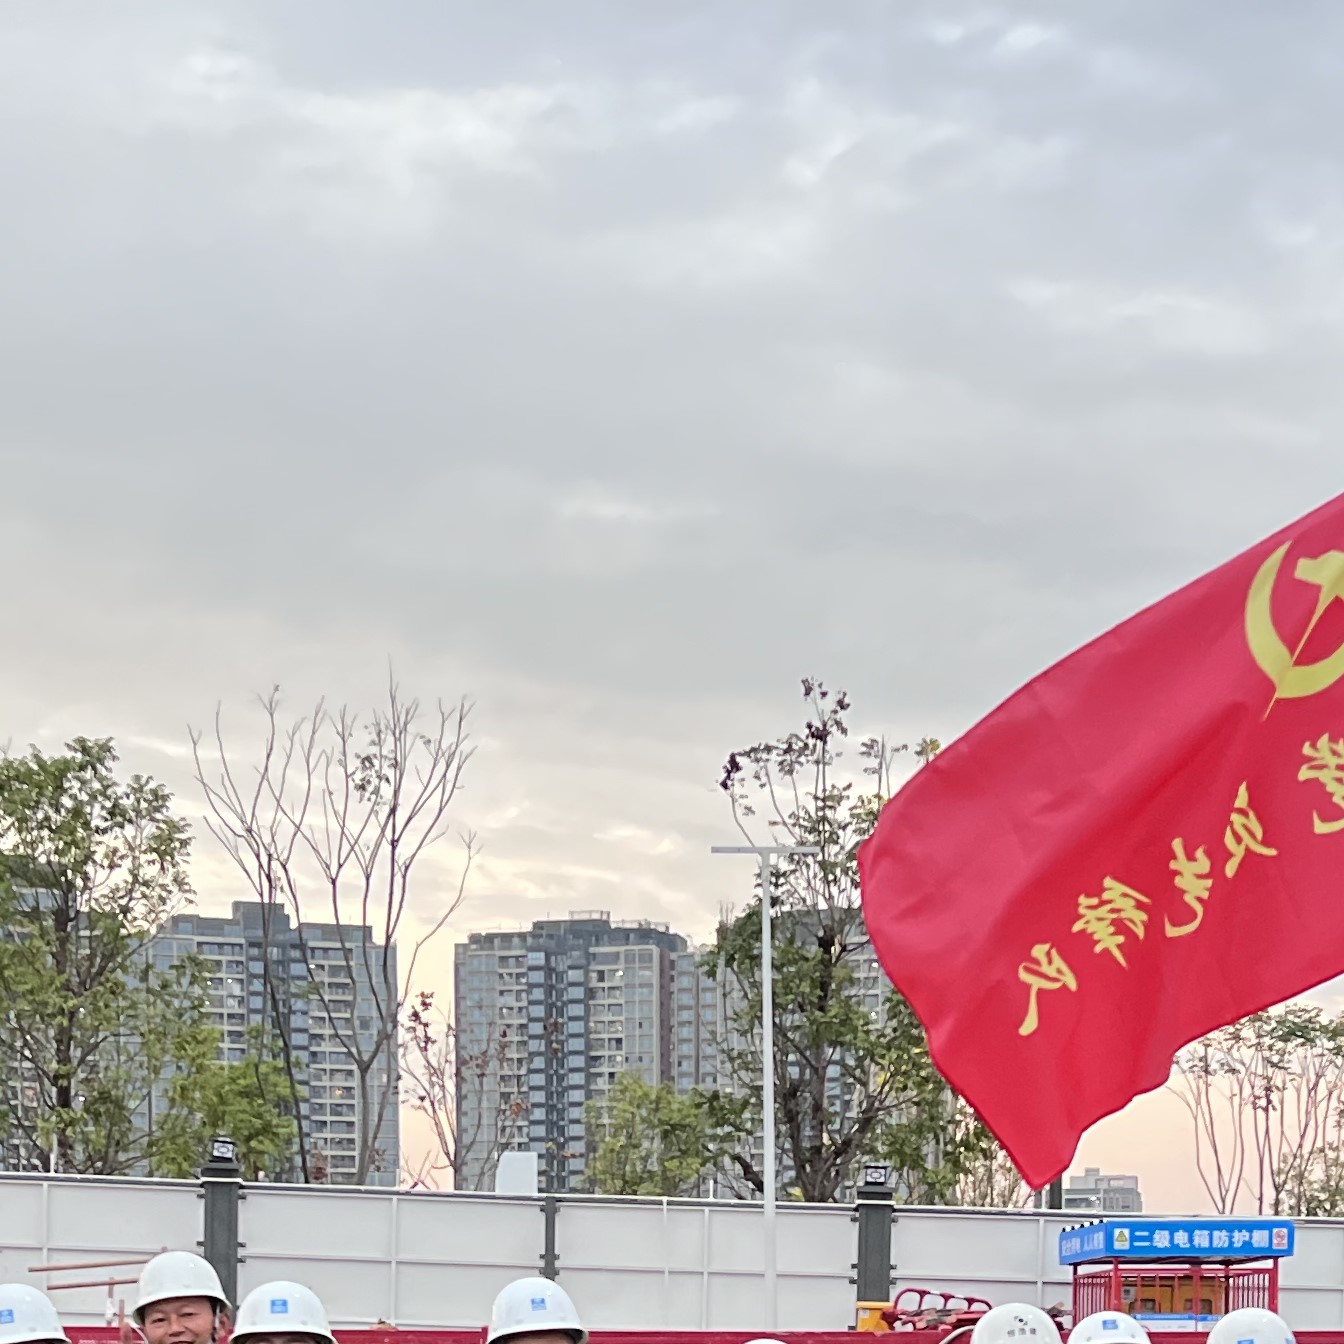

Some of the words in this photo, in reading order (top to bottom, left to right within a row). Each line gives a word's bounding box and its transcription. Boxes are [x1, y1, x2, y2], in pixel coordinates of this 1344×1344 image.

[1132, 1229, 1270, 1249] 二级电箱防护棚
